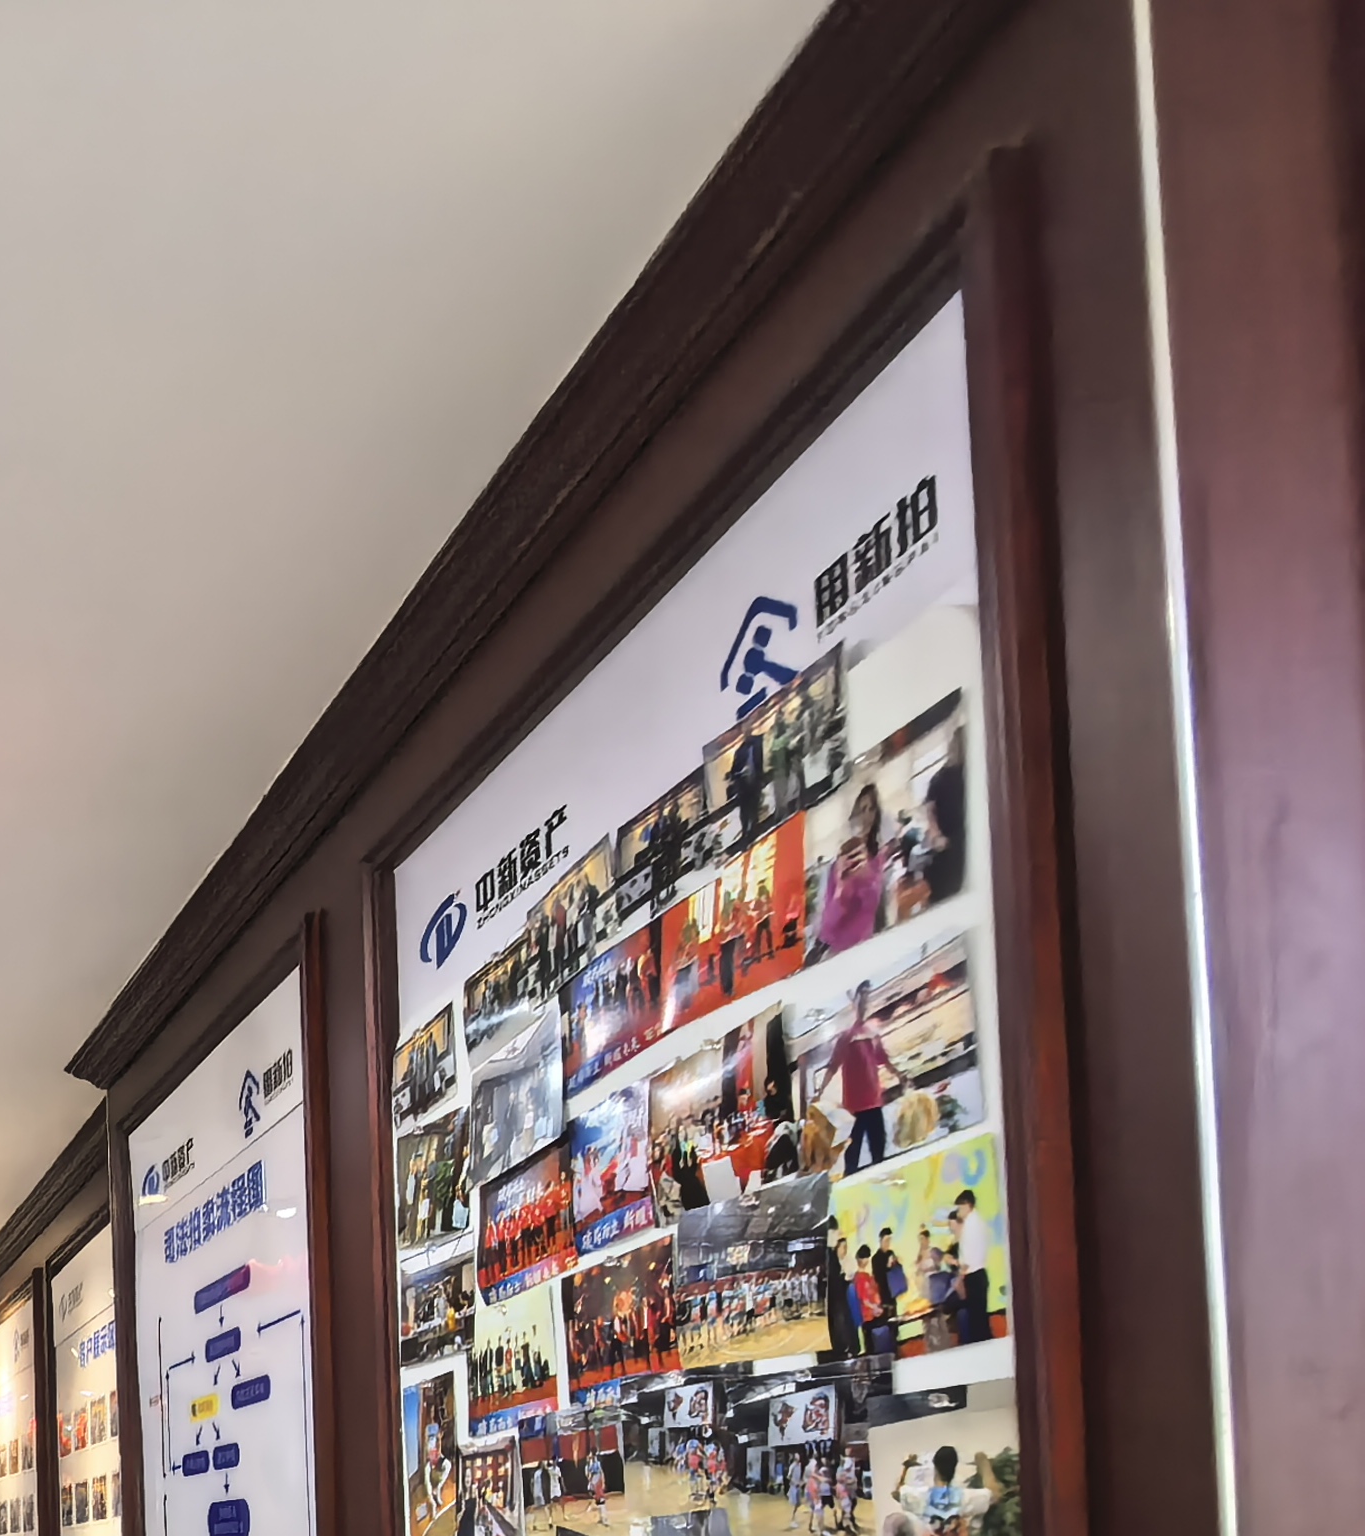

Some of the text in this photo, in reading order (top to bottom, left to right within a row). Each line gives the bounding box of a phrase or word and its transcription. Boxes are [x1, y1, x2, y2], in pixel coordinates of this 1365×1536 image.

[475, 804, 568, 913] 中新资产
[164, 1160, 265, 1264] 司法拍卖流程图
